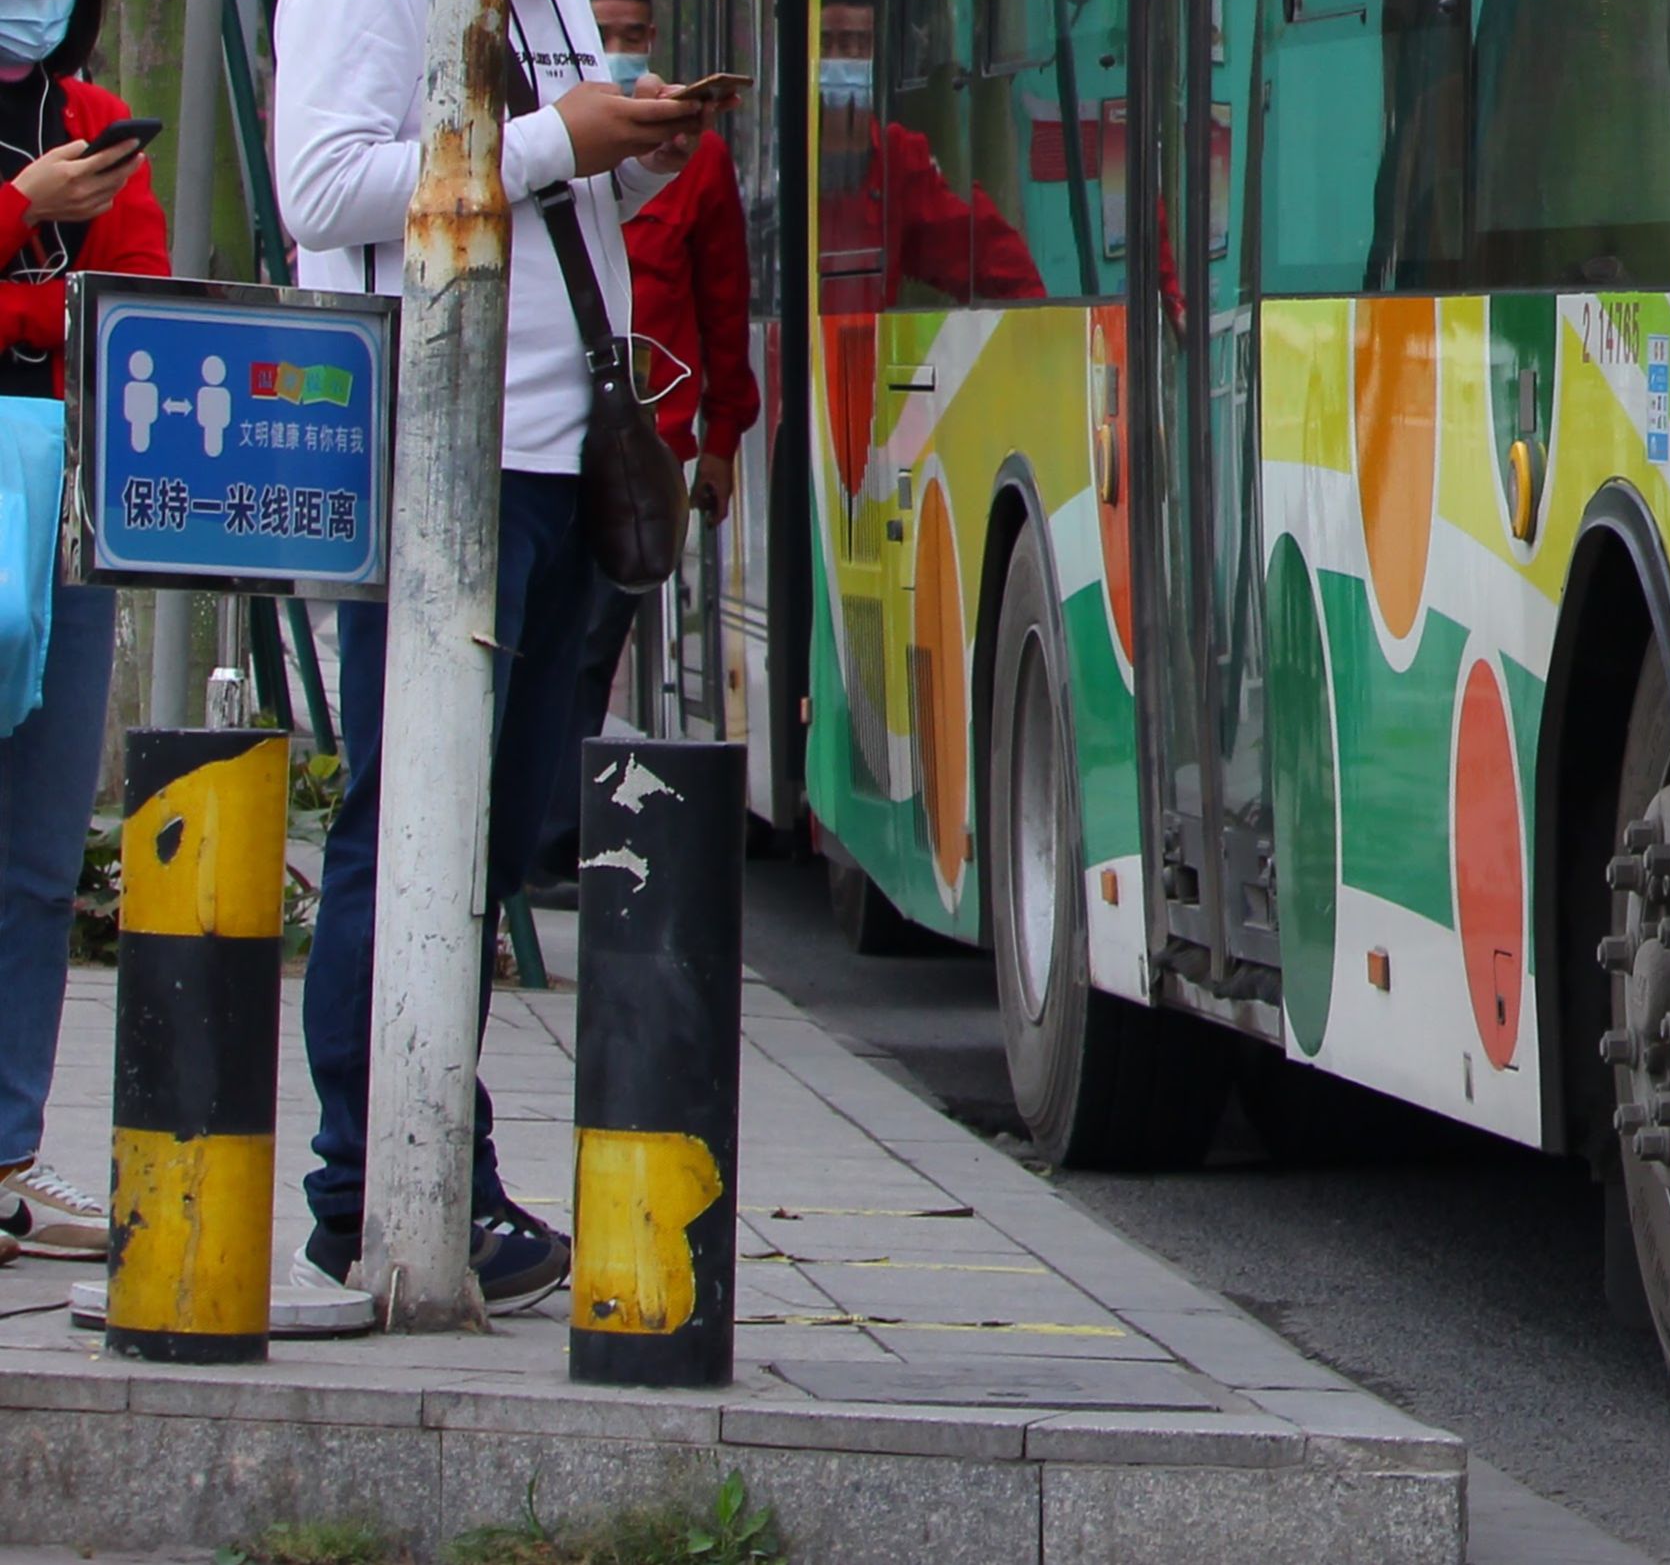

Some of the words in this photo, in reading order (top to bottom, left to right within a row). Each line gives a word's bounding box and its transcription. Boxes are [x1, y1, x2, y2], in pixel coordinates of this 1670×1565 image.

[239, 419, 300, 451] 文明健康
[304, 423, 364, 454] 有你有我
[121, 475, 358, 540] 保持一米线距离
